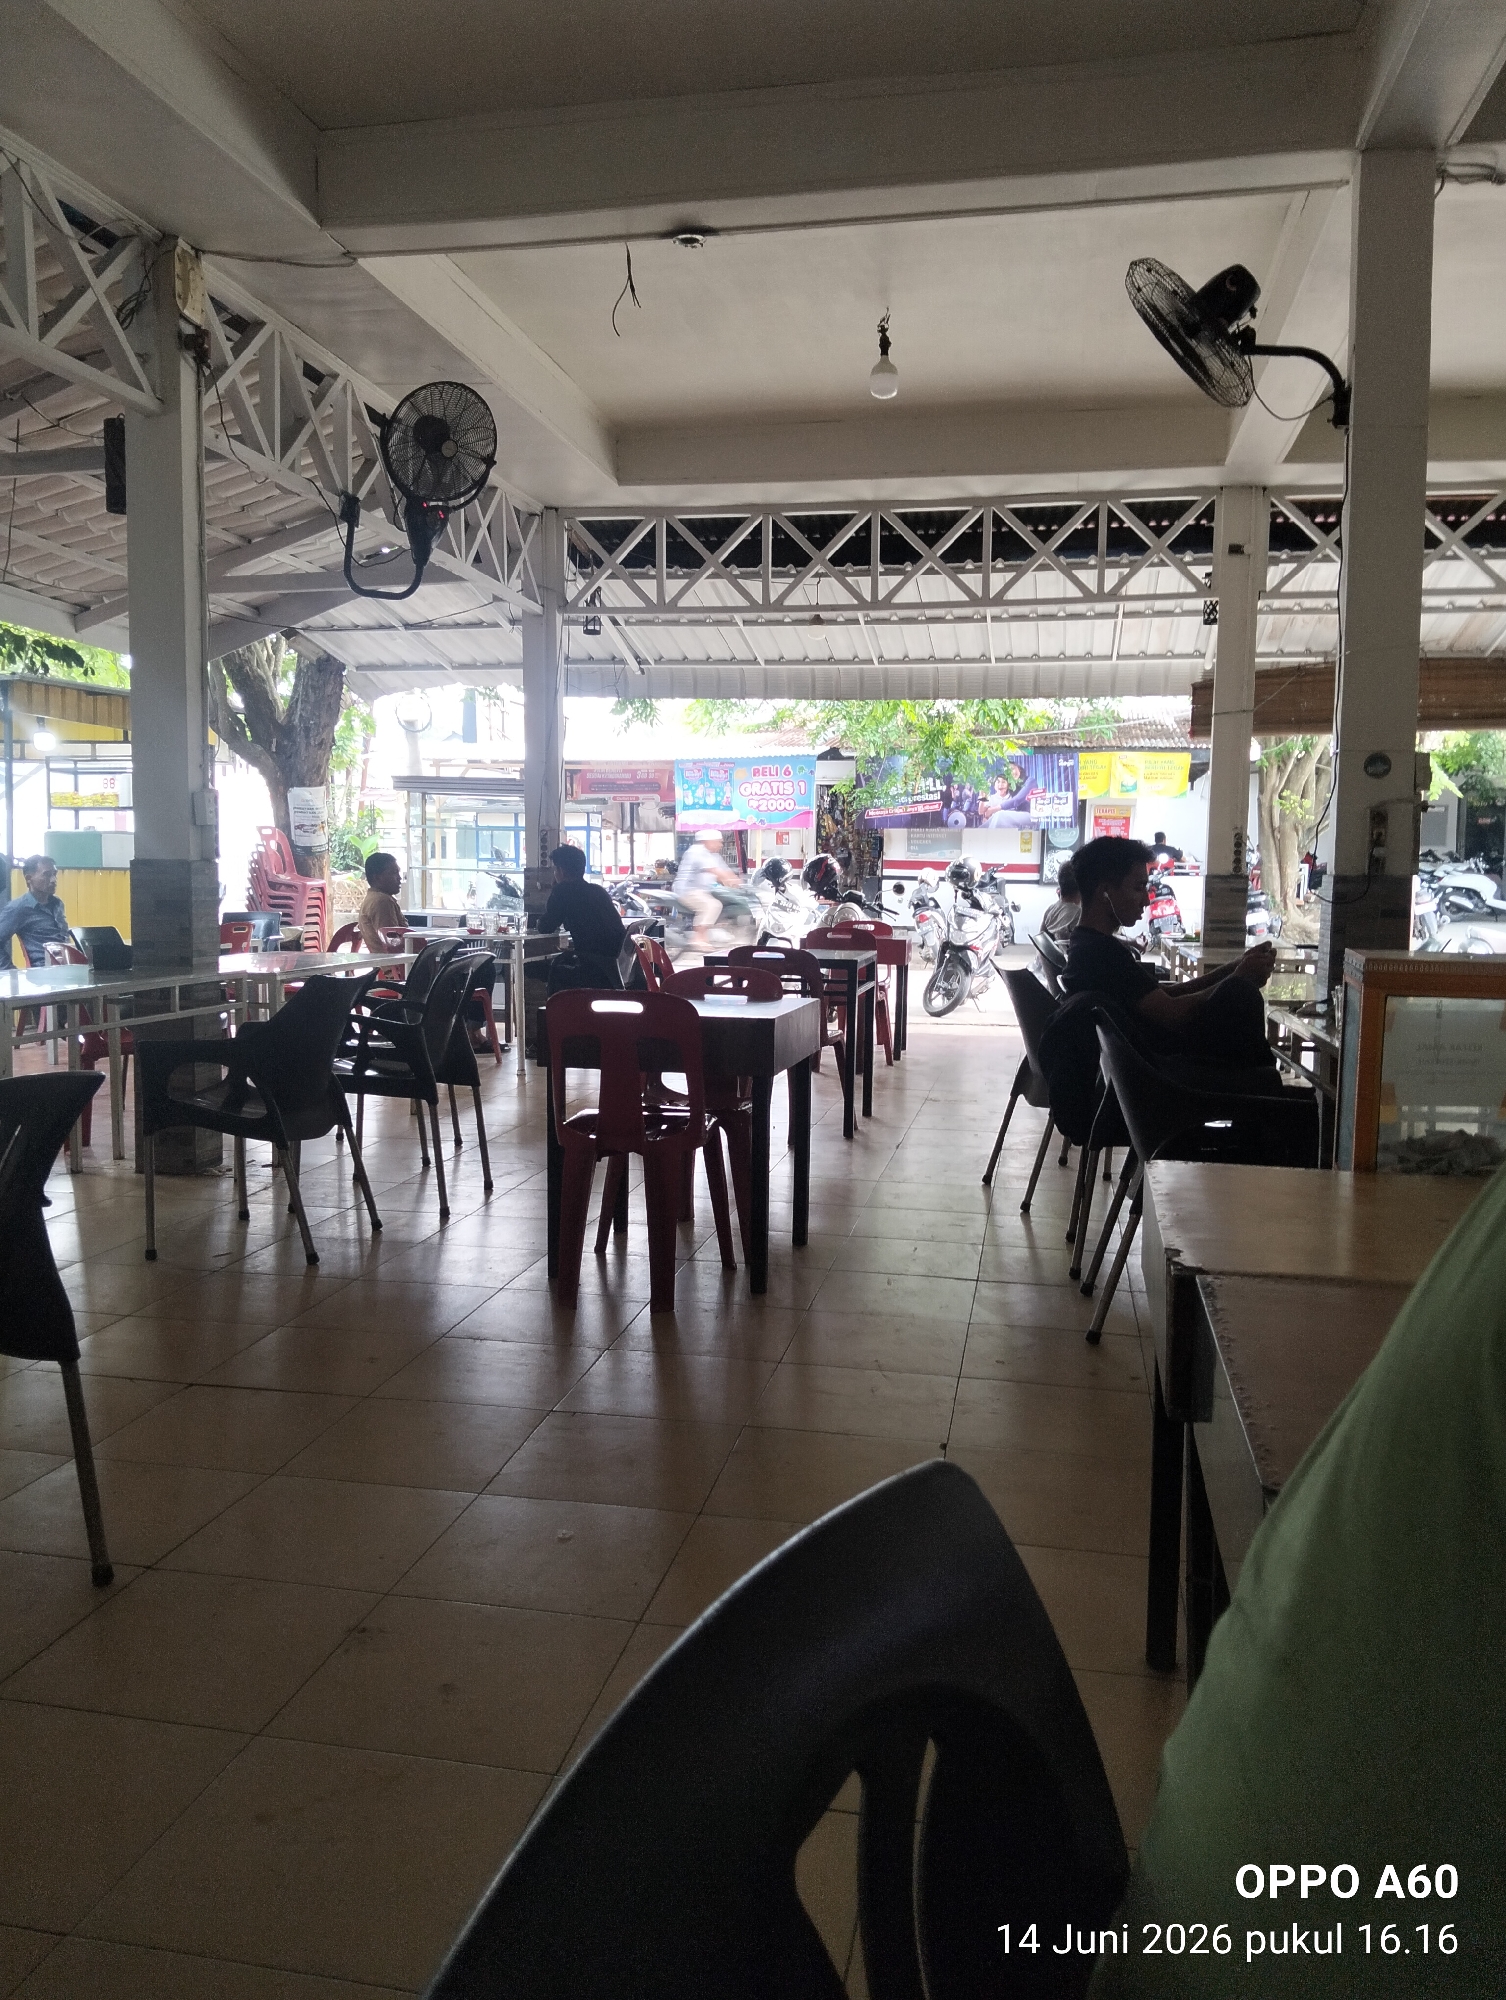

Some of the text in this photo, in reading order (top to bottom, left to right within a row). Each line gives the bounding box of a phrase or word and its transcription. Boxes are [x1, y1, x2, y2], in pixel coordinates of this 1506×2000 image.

[752, 765, 792, 778] BELI 6
[739, 780, 807, 797] GRATIS 1
